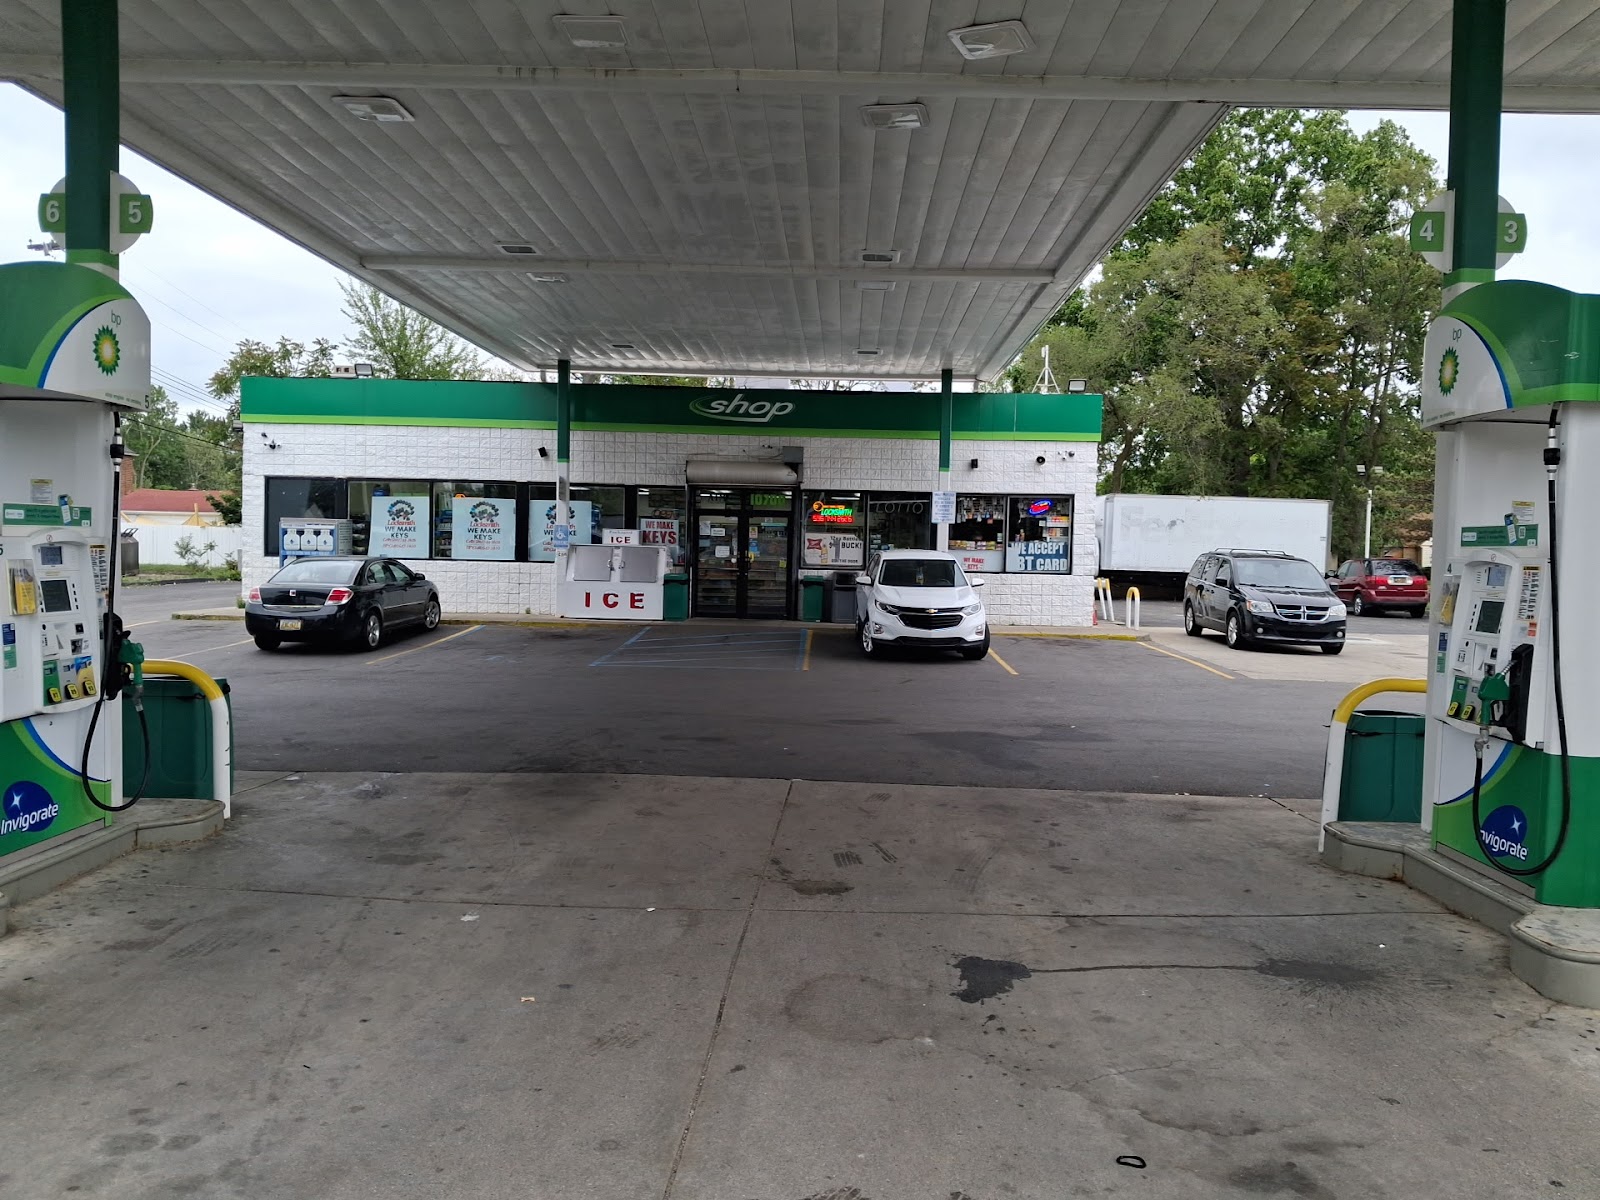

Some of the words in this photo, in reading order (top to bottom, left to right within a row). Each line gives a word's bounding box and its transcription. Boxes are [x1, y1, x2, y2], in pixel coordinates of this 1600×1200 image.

[45, 200, 60, 223] 6
[128, 201, 143, 224] 5
[1419, 219, 1434, 242] 4
[1504, 220, 1518, 243] 3
[110, 310, 122, 327] bp
[1452, 327, 1462, 342] bp
[144, 394, 150, 409] 5
[707, 393, 795, 422] shop
[820, 508, 853, 516] LOCKSMITH
[876, 502, 924, 514] LOTTO
[645, 520, 655, 529] WE
[656, 521, 674, 530] MAKE
[610, 536, 631, 544] ICE
[642, 530, 677, 544] KEYS
[1028, 542, 1065, 555] ACCEPT
[1018, 555, 1034, 571] BT
[1036, 558, 1068, 571] CARD
[1446, 563, 1452, 574] 4
[584, 591, 645, 609] ICE
[0, 804, 58, 835] Invigorate
[1480, 829, 1528, 860] nvigorate
